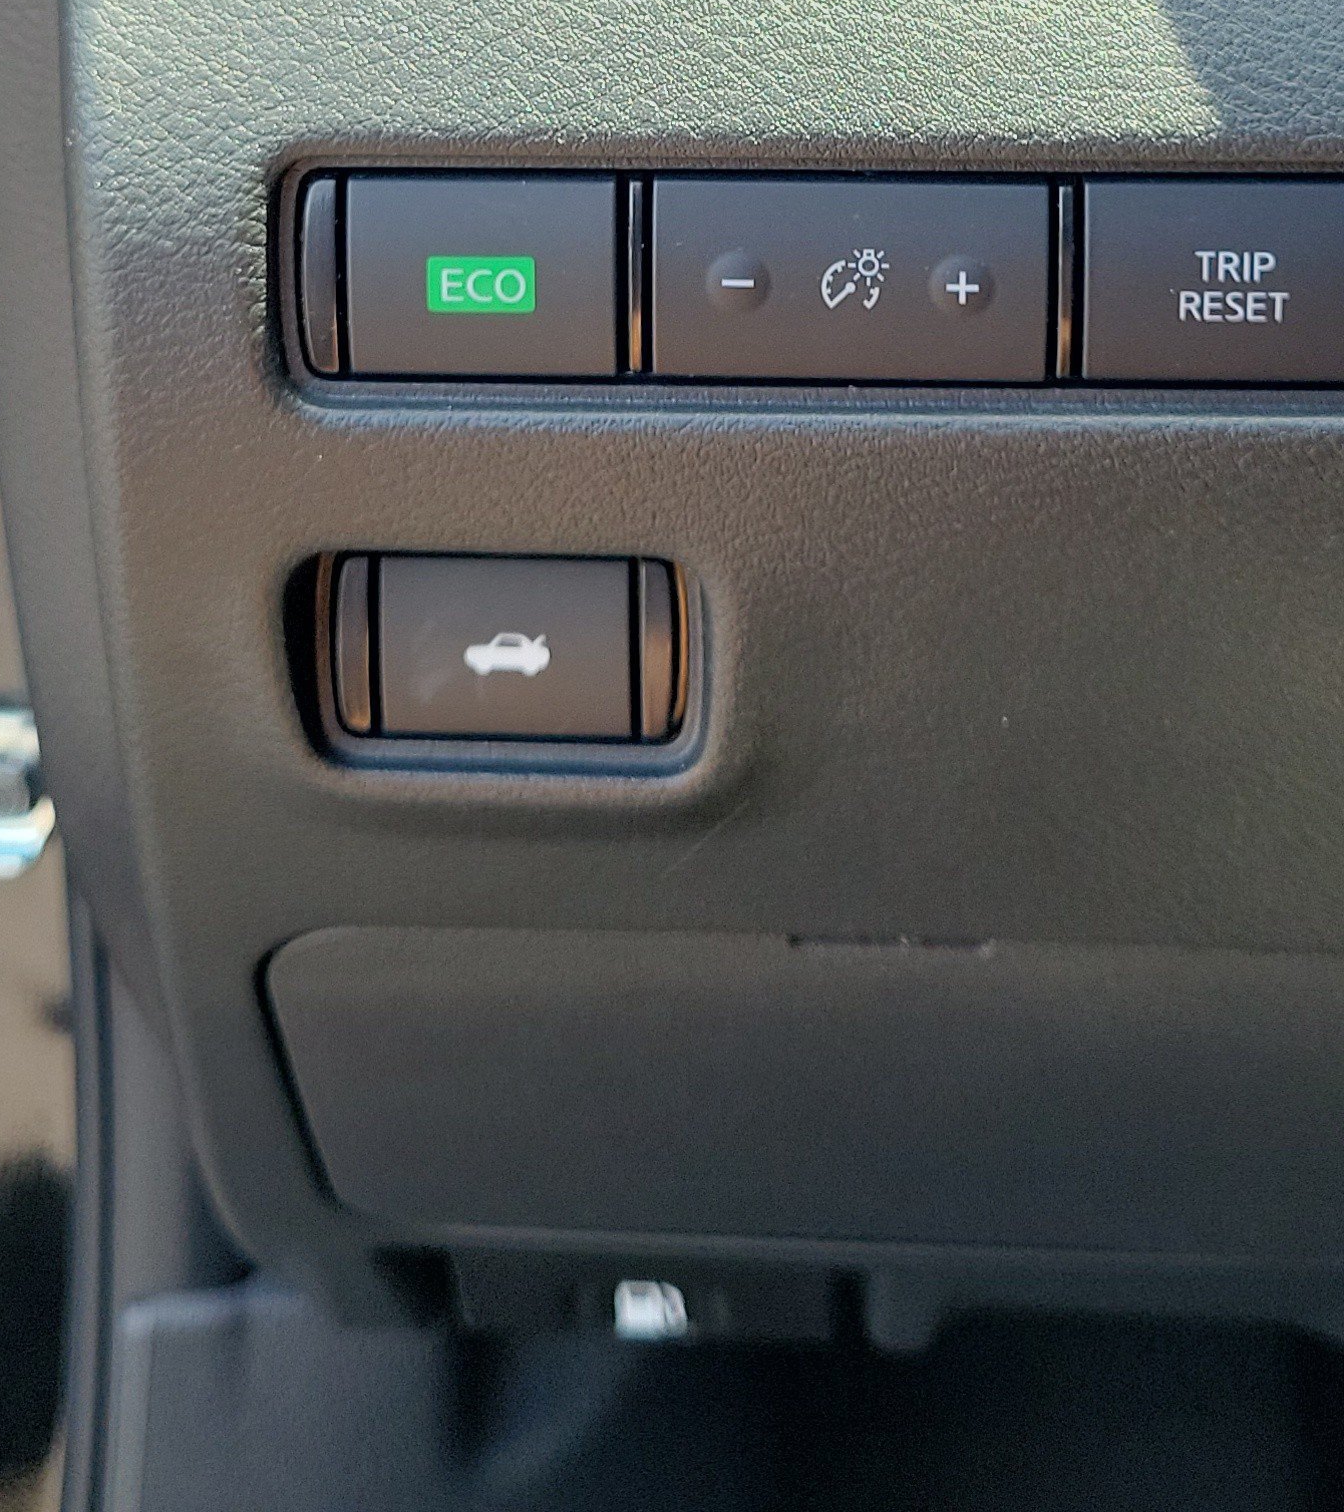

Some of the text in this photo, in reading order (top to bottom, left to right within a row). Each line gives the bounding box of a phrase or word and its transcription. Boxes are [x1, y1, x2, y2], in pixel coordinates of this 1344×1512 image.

[1194, 250, 1277, 283] TRIP
[439, 268, 527, 304] ECO
[1178, 291, 1290, 323] RESET
